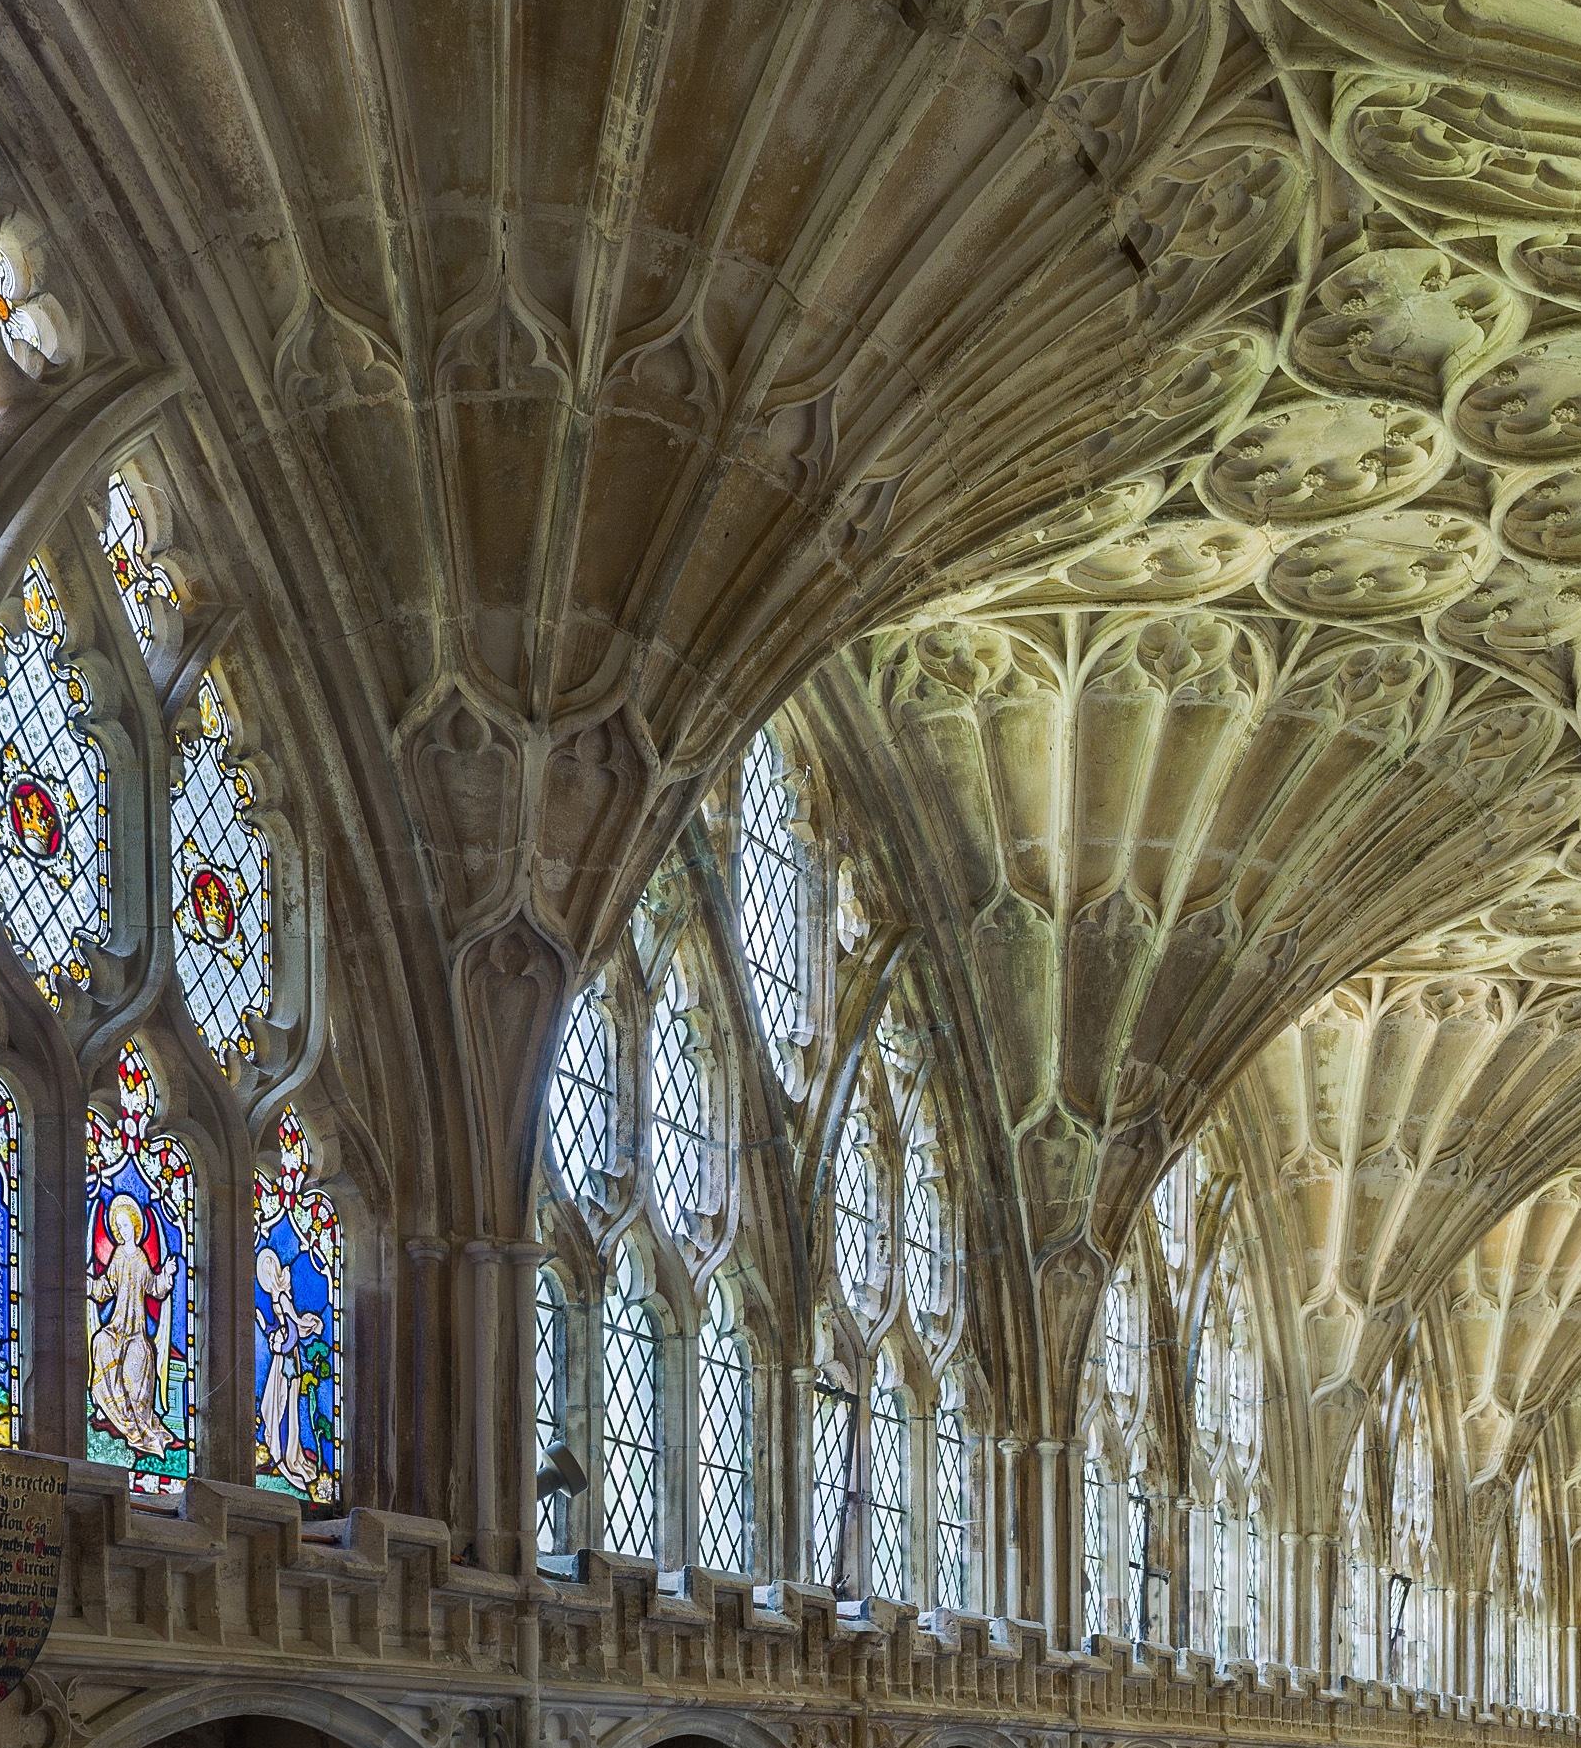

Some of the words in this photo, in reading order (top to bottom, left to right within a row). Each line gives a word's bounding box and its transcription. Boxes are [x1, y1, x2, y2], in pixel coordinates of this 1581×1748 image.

[1, 1468, 12, 1490] is
[15, 1475, 55, 1494] erected
[57, 1477, 67, 1496] in
[13, 1494, 28, 1510] of
[23, 1537, 36, 1554] for
[40, 1581, 58, 1601] him
[4, 1620, 27, 1637] loss
[28, 1626, 40, 1638] as
